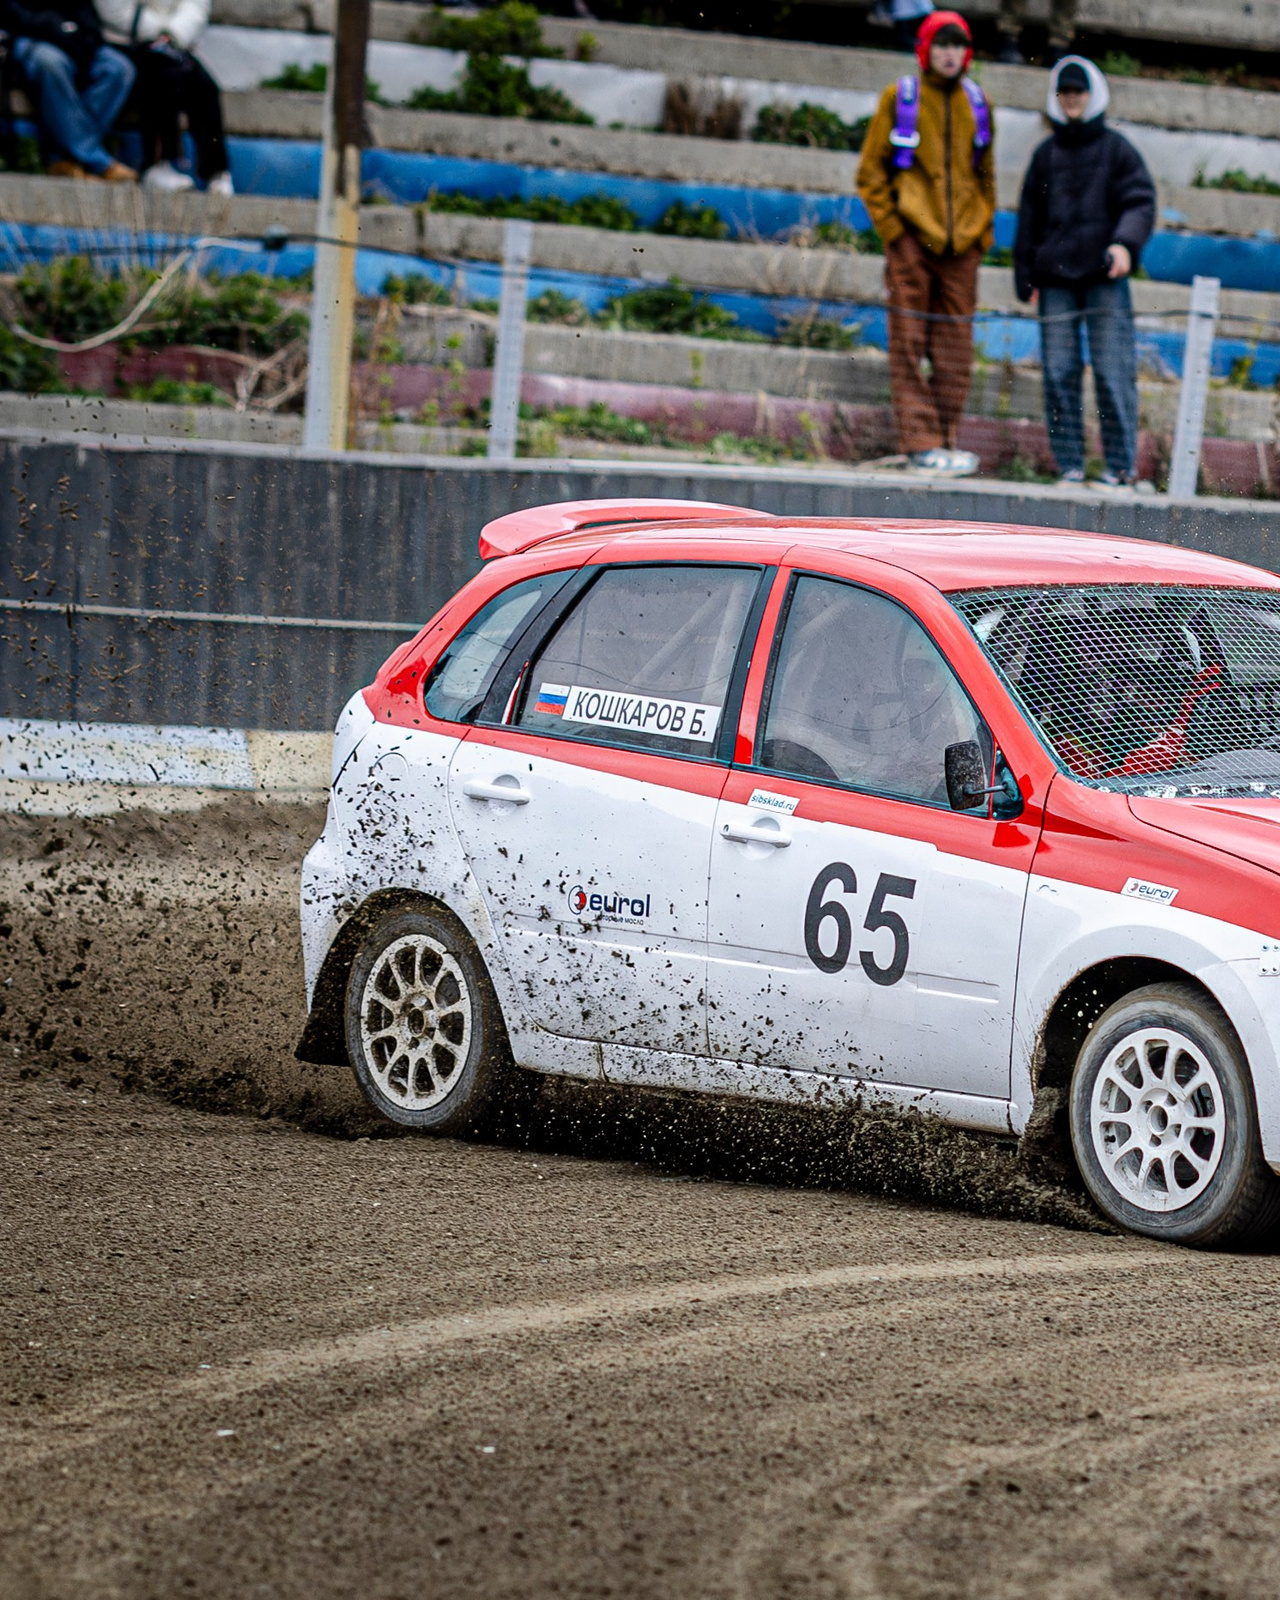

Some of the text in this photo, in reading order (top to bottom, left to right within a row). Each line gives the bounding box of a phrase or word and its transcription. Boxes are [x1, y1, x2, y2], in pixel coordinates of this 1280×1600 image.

[572, 690, 707, 737] КОШКАРОВ Б.
[750, 794, 796, 811] sibsklad.ru
[1138, 884, 1175, 900] eurol
[589, 894, 651, 917] eurol
[804, 861, 917, 986] 65
